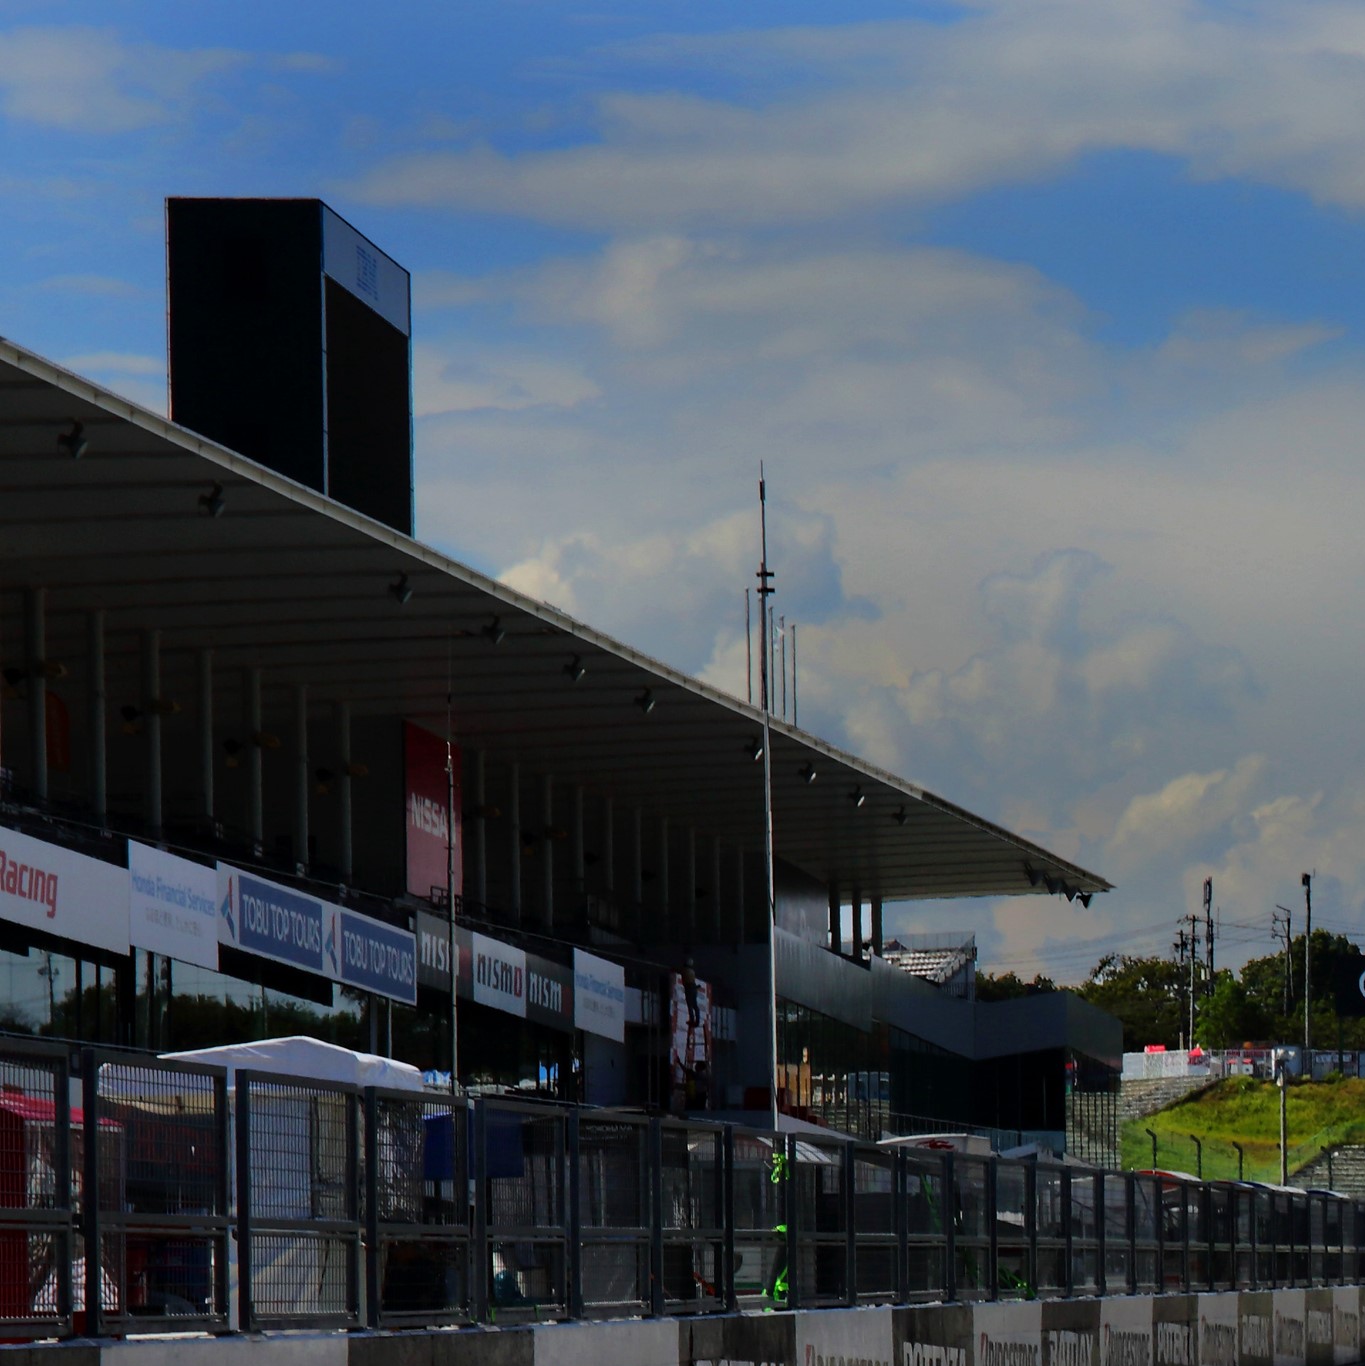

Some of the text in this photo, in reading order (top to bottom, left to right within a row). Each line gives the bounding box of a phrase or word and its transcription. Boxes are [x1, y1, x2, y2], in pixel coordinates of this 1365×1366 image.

[242, 894, 269, 936] TOBU
[270, 903, 290, 942] TOP
[290, 910, 320, 953] TOURS
[344, 930, 413, 985] TOBU TOP TOURS
